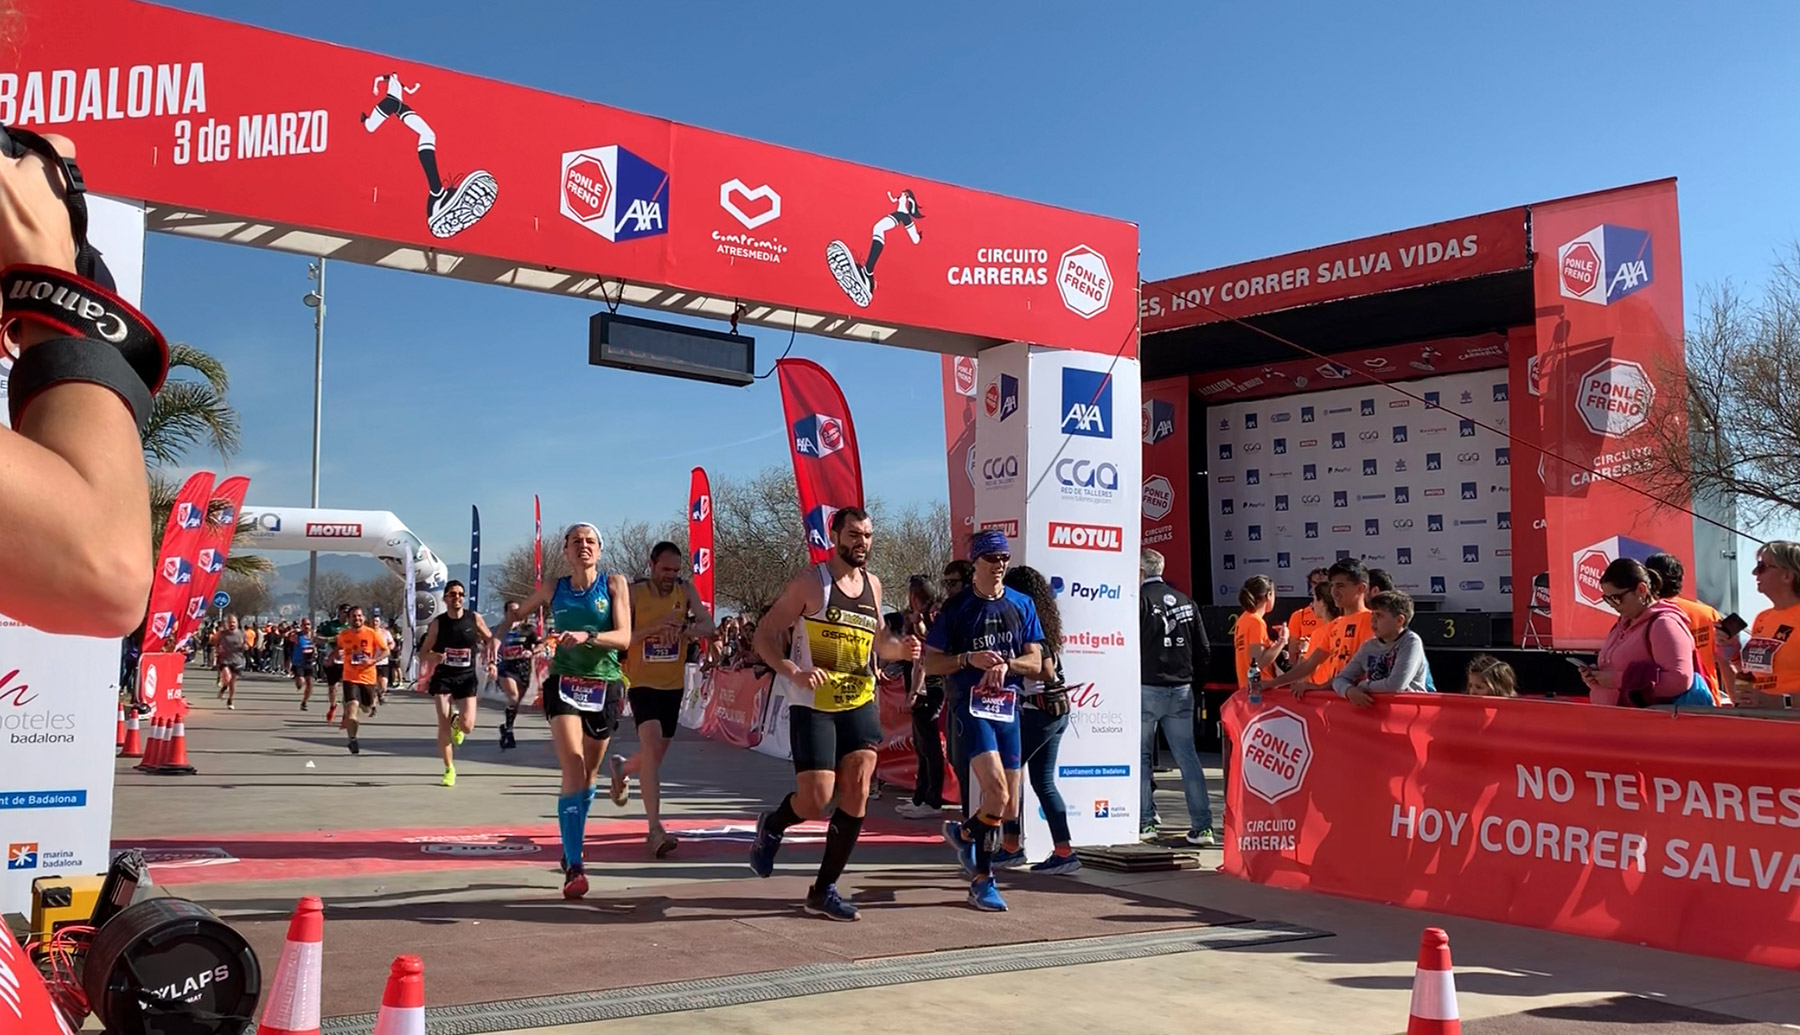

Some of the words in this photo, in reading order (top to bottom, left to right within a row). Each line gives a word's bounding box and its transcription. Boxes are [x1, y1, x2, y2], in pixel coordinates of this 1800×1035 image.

[0, 62, 206, 125] BADALONA
[173, 119, 193, 165] 3
[199, 122, 231, 163] de
[238, 110, 328, 159] MARZO
[569, 170, 603, 194] PONLE
[566, 181, 599, 209] FRENO
[614, 199, 663, 233] AXA
[716, 244, 781, 264] ATRESMEDIA
[977, 248, 1048, 264] CIRCUITO
[1171, 285, 1215, 312] HOY
[1221, 268, 1309, 302] CORRER
[1317, 251, 1392, 284] SALVA
[1399, 235, 1478, 269] VIDAS
[1565, 257, 1594, 272] PONLE
[947, 266, 1048, 286] CARRERAS
[1068, 260, 1106, 290] PONLE
[1564, 267, 1592, 283] FRENO
[1607, 260, 1649, 297] AXA
[1064, 273, 1102, 302] FRENO
[9, 280, 129, 343] Canon
[1590, 380, 1645, 401] PONLE
[1586, 395, 1642, 416] FRENO
[1061, 403, 1105, 432] AXA
[1084, 489, 1113, 498] TALLERES
[1144, 487, 1170, 500] PONLE
[308, 525, 360, 536] MOTUL
[1052, 526, 1119, 548] MOTUL
[1580, 564, 1604, 580] PONL
[1071, 582, 1121, 601] PayPal
[1443, 619, 1455, 639] 3
[972, 634, 996, 650] ESTO
[997, 631, 1013, 643] NO
[1061, 631, 1125, 648] ontigalà
[10, 733, 74, 744] badalona
[1091, 726, 1123, 734] badalona
[1252, 728, 1303, 765] PONLE
[1062, 768, 1094, 776] Ajuntament
[1244, 745, 1296, 781] FRENO
[12, 796, 26, 805] de
[28, 795, 77, 805] Badalona
[1516, 764, 1575, 803] NO
[1585, 770, 1640, 811] TE
[1653, 777, 1800, 828] PARES
[1247, 819, 1296, 832] CIRCUITO
[43, 850, 74, 859] marina
[1390, 804, 1468, 847] HOY
[1480, 815, 1647, 873] CORRER
[1662, 838, 1800, 893] SALVA
[42, 859, 83, 868] badalona
